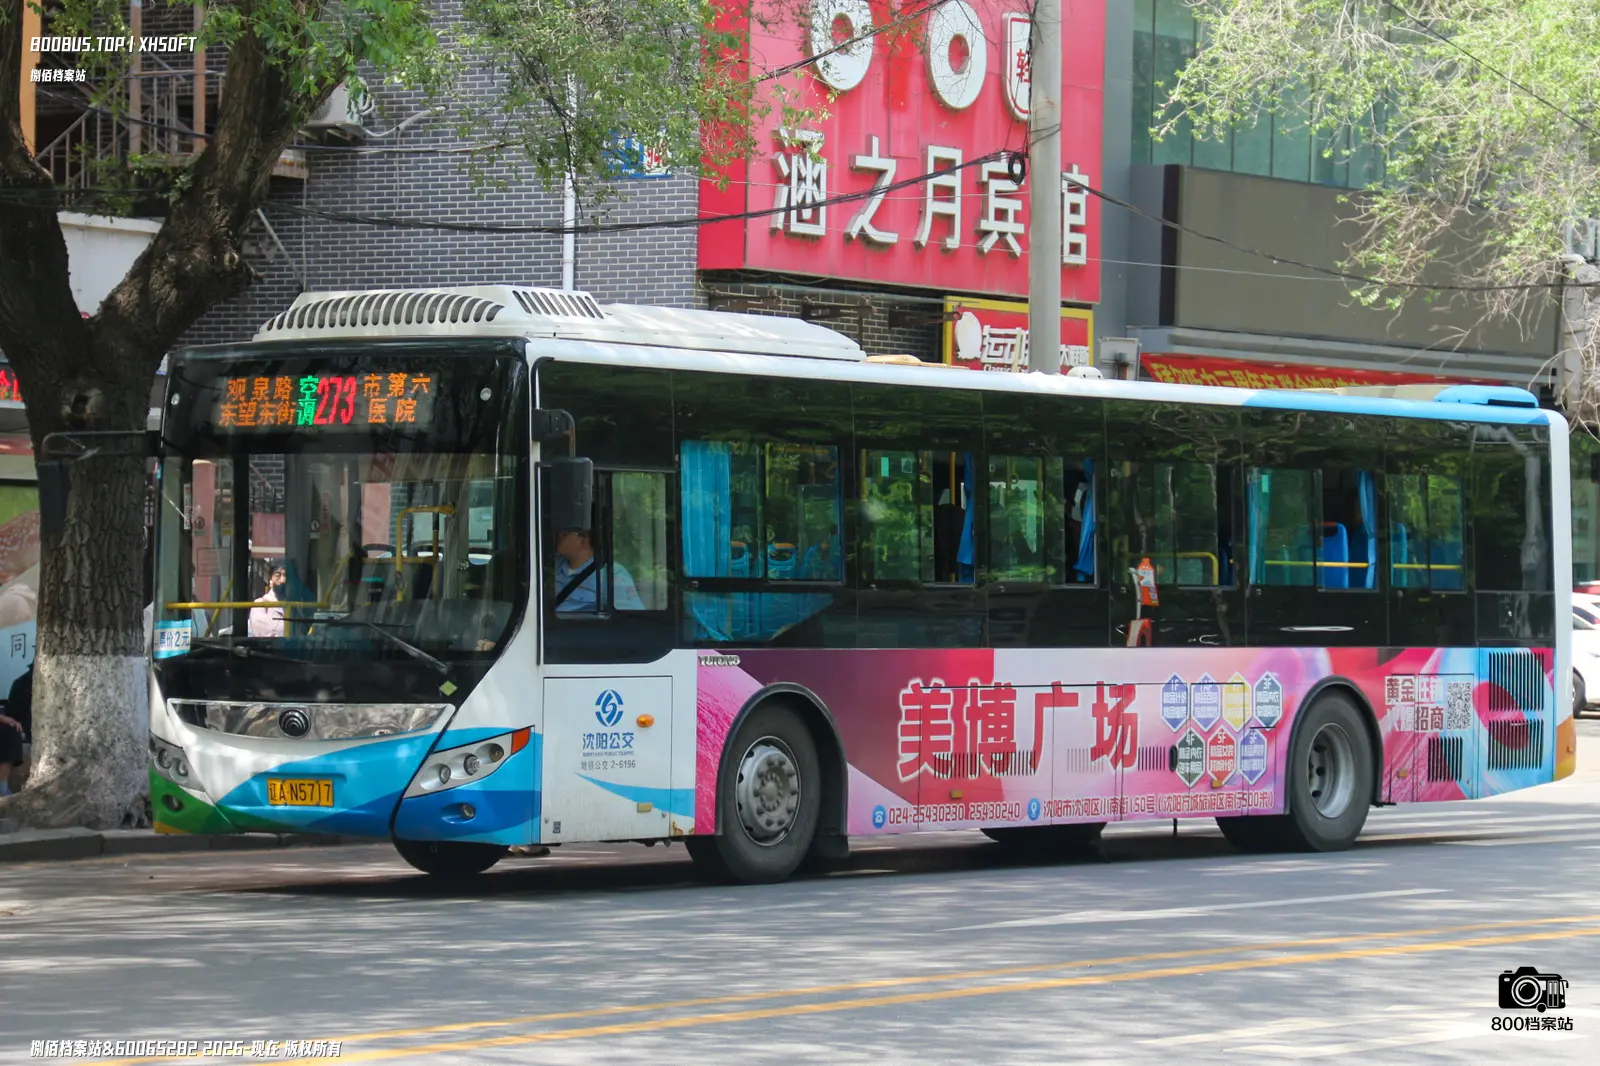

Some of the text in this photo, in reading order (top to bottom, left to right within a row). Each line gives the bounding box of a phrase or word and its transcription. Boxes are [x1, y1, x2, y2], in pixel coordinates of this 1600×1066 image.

[226, 376, 293, 401] 观泉路
[363, 373, 431, 397] 市第六
[297, 375, 319, 425] 空调
[313, 376, 357, 424] 273
[367, 397, 417, 424] 医院
[219, 401, 296, 426] 东望东街
[160, 630, 190, 648] 票价2元
[582, 731, 635, 750] 沈阳公交
[898, 678, 1138, 782] 美博广场
[611, 759, 636, 769] 2-6196
[888, 802, 1021, 825] 024-25430230 25430240
